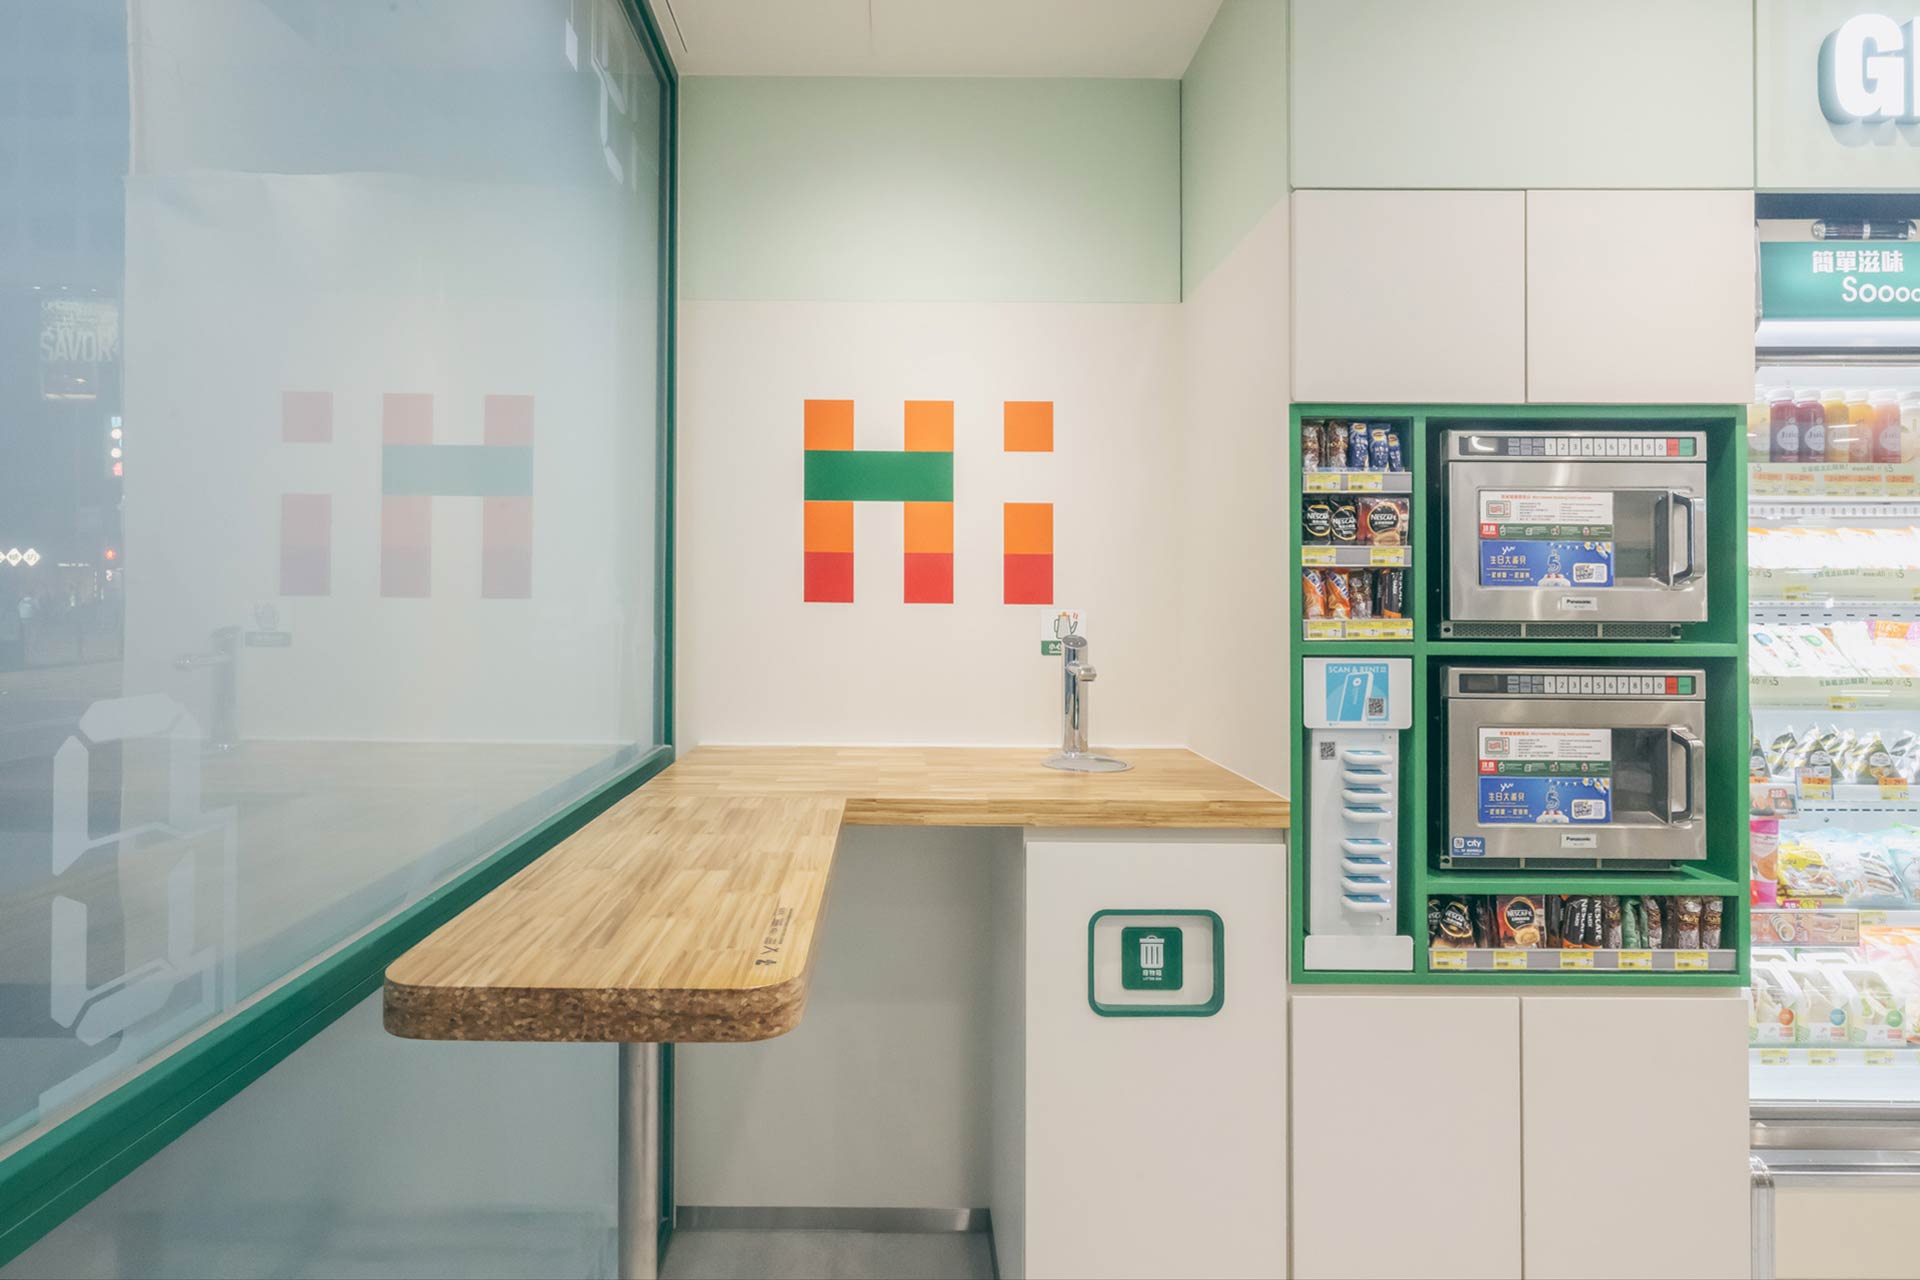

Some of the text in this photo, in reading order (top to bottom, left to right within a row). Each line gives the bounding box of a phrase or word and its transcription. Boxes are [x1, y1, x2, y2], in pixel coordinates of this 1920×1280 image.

[1834, 13, 1920, 118] G
[1812, 249, 1905, 274] 簡單滋味
[804, 400, 1053, 605] Hi
[1328, 665, 1350, 673] SCAN
